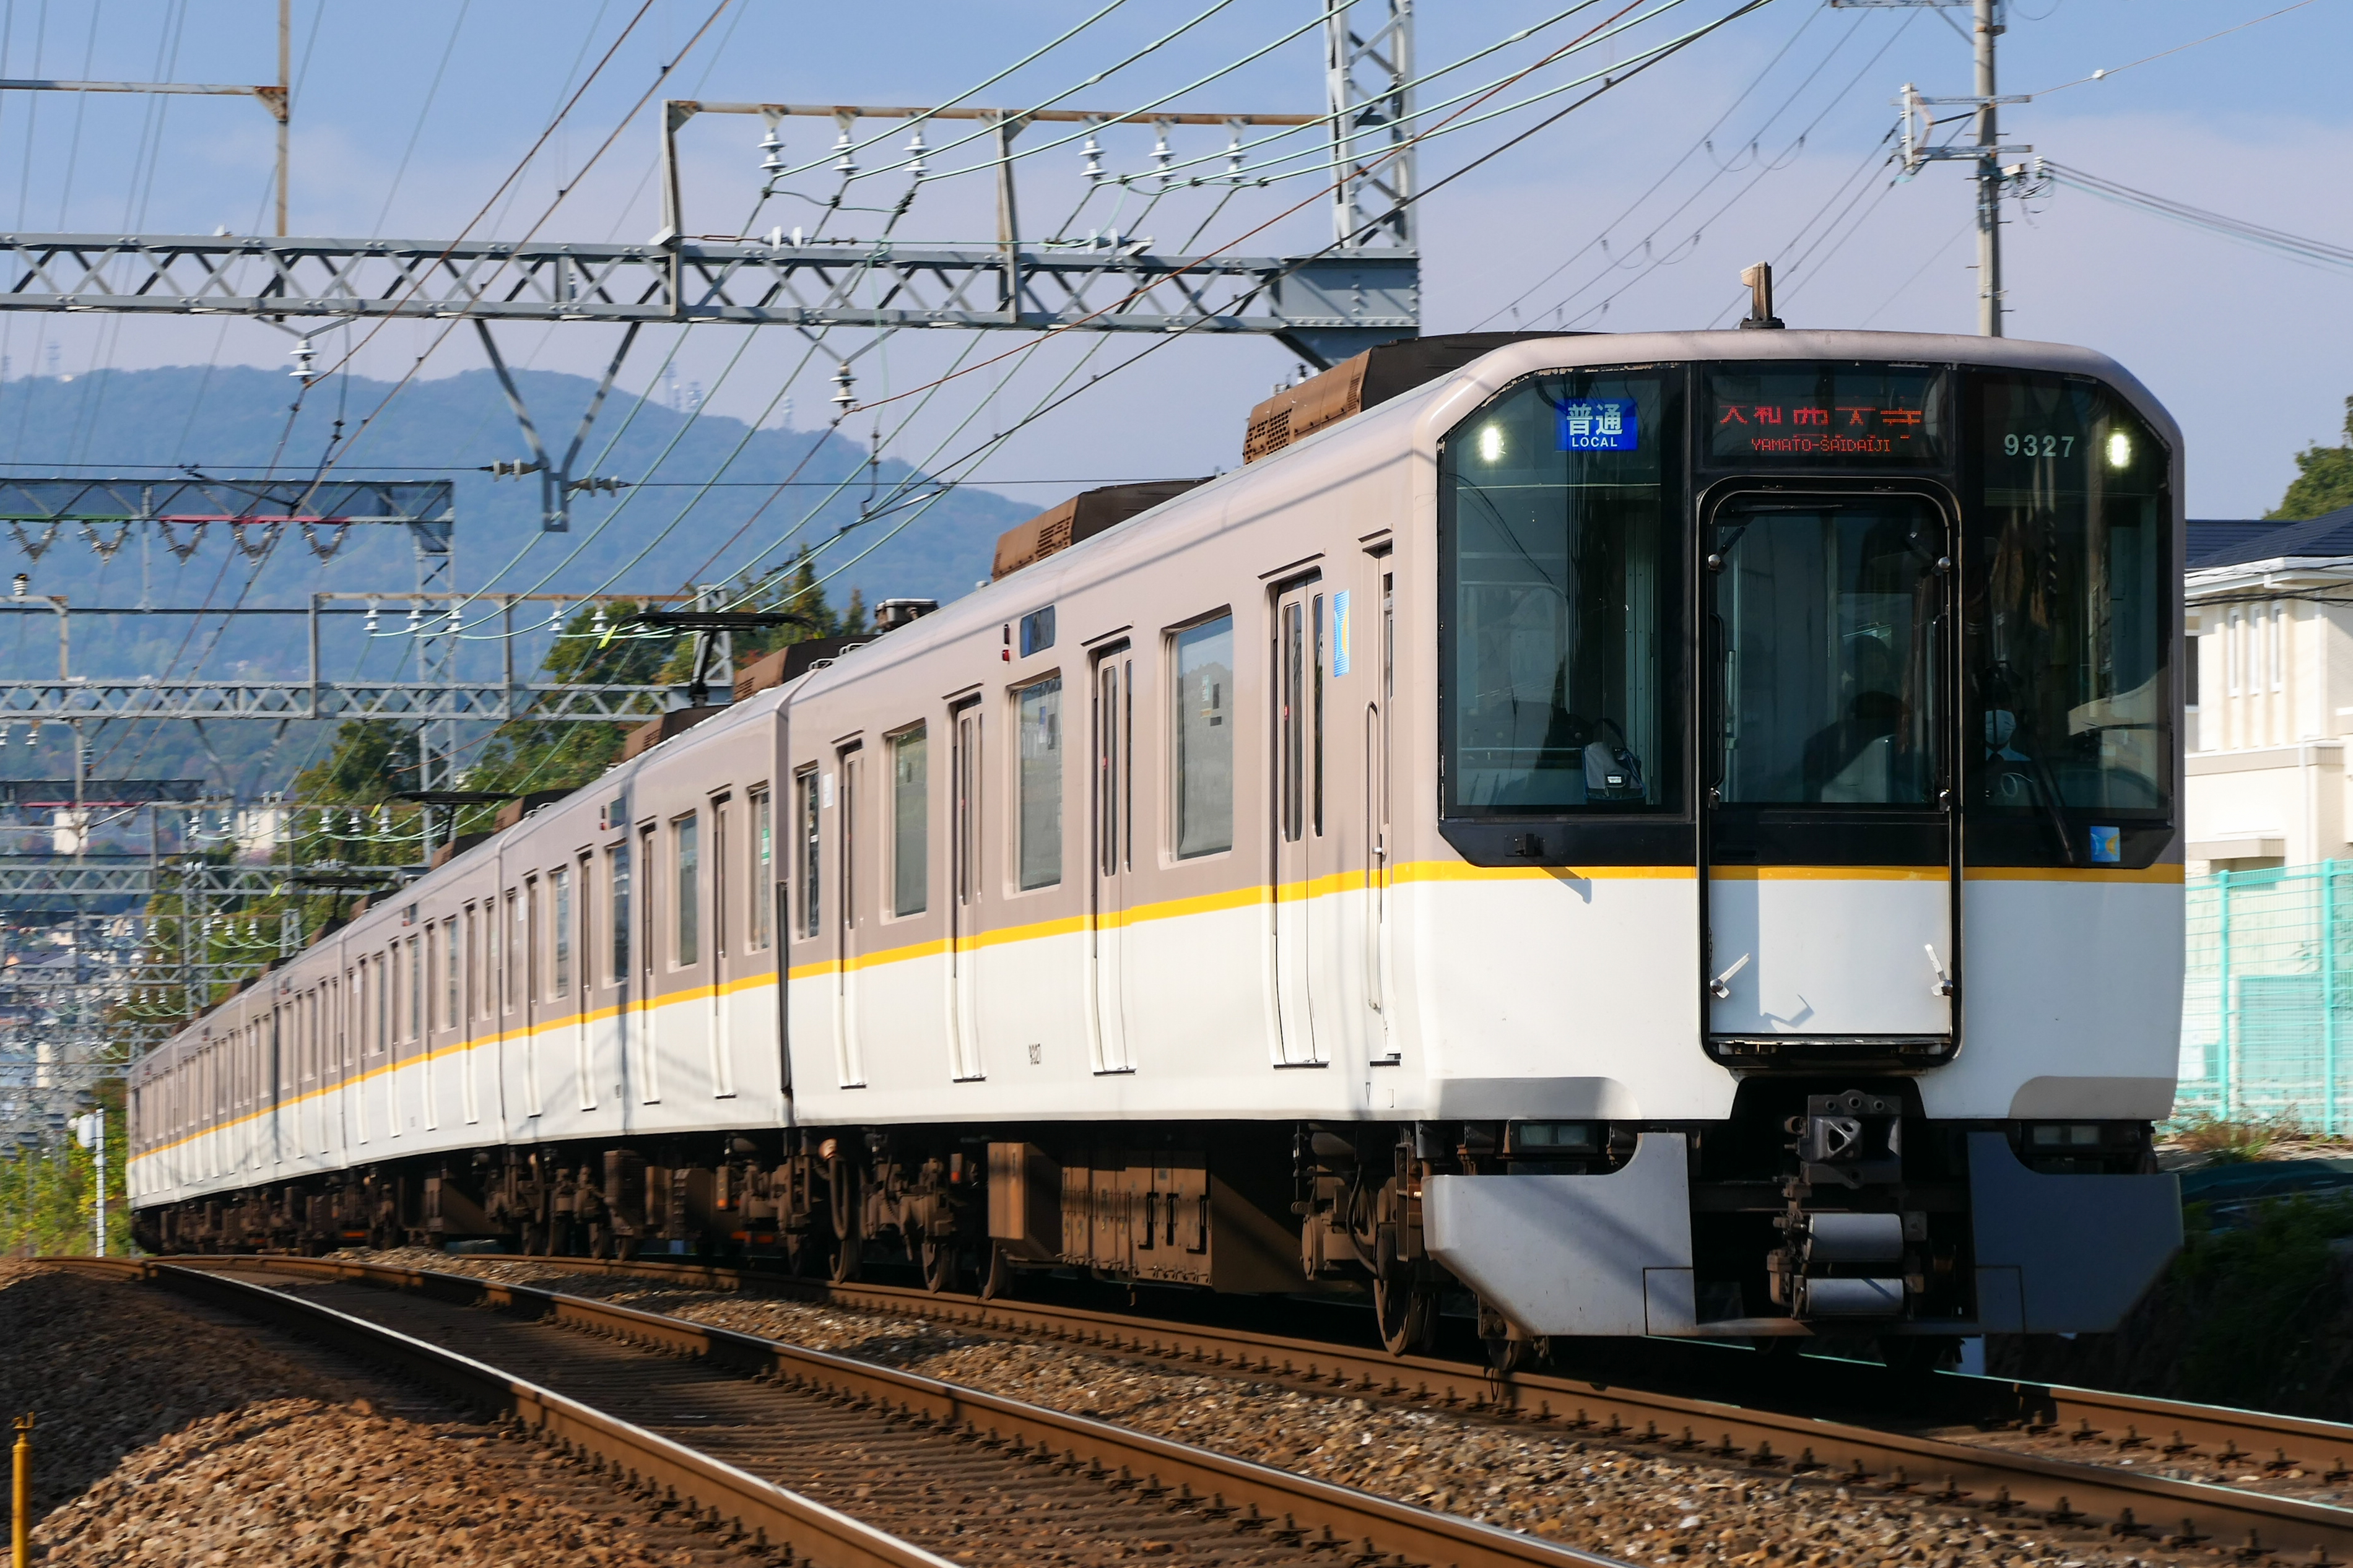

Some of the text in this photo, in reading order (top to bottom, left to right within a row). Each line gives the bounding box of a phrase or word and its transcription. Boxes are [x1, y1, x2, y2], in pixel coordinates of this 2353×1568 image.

[1567, 403, 1623, 436] 普通
[1572, 436, 1618, 448] LOCAL
[1751, 438, 1890, 452] YAMATO-SAIDAIJI
[2004, 433, 2075, 458] 9327
